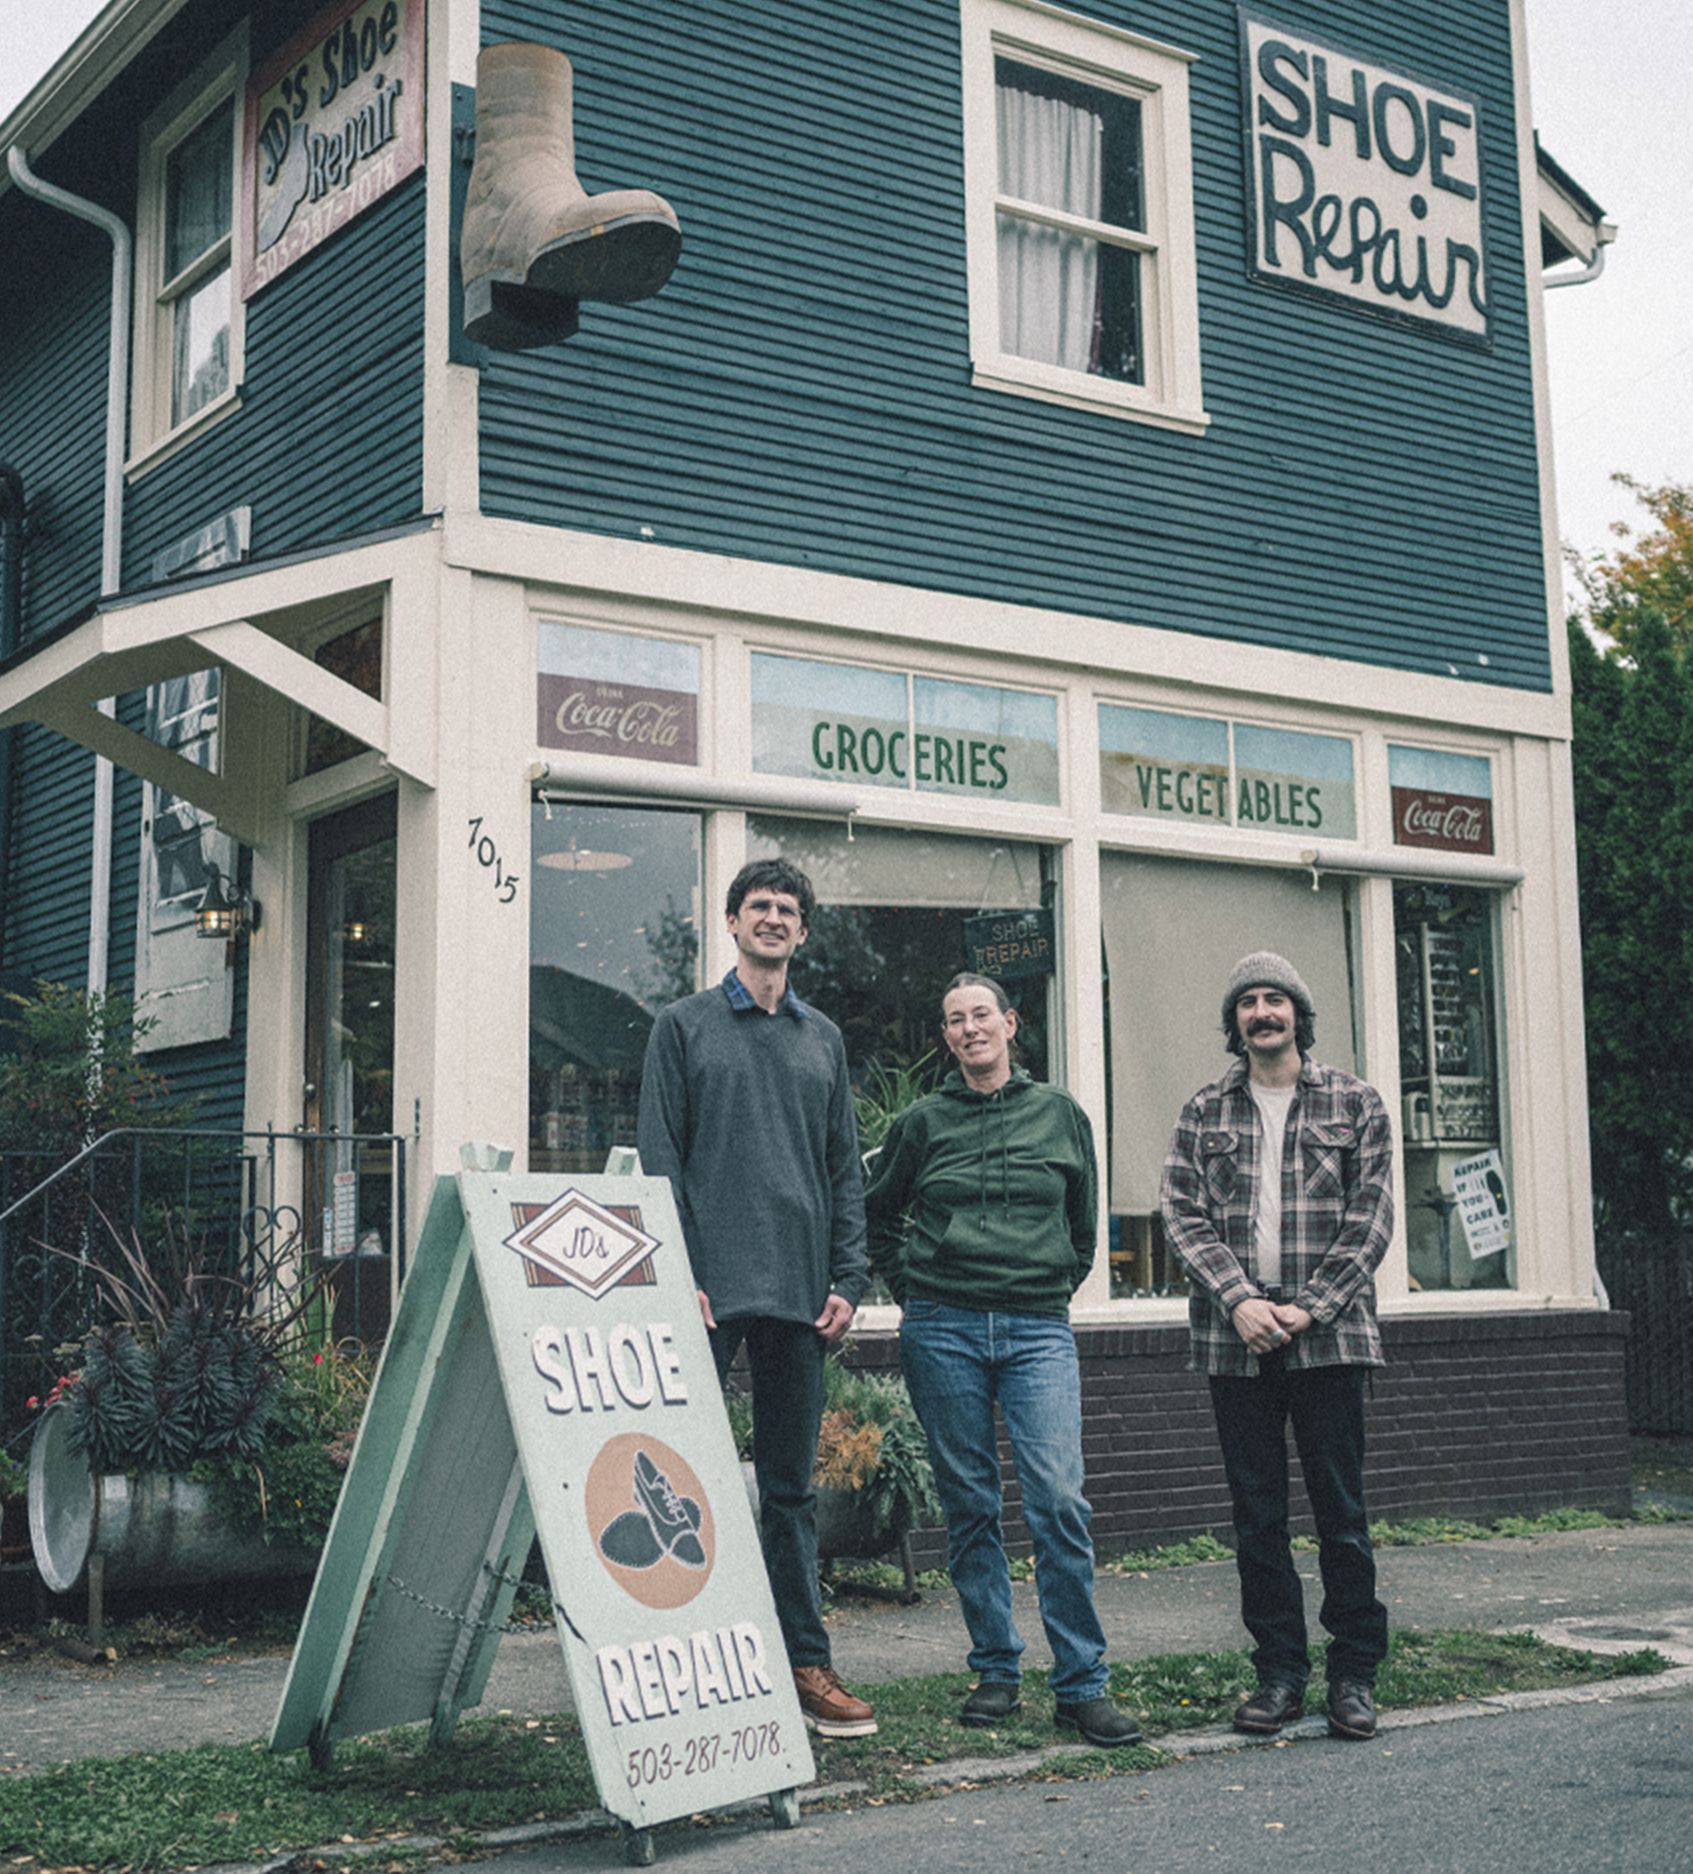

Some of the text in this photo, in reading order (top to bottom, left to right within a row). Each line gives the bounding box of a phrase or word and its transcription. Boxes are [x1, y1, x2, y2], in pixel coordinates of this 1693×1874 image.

[259, 1, 398, 186] JD's Shoe
[1257, 39, 1477, 202] SHOE
[309, 73, 402, 204] Repair
[255, 152, 396, 286] 503-287-7078
[1258, 133, 1491, 319] Repair
[556, 691, 684, 747] Coca-Cola
[812, 721, 1008, 790] GROCERIES
[1136, 765, 1323, 829] VEGETABLES
[1403, 800, 1482, 841] Coca-Cola
[468, 817, 519, 904] 7015
[986, 937, 1050, 965] REPAIR
[992, 920, 1039, 942] SHOE
[1454, 1158, 1492, 1178] REPAIR
[1466, 1207, 1494, 1225] CARE
[531, 1322, 688, 1416] SHOE
[595, 1620, 773, 1728] REPAIR
[626, 1720, 781, 1789] 503-287-7078
